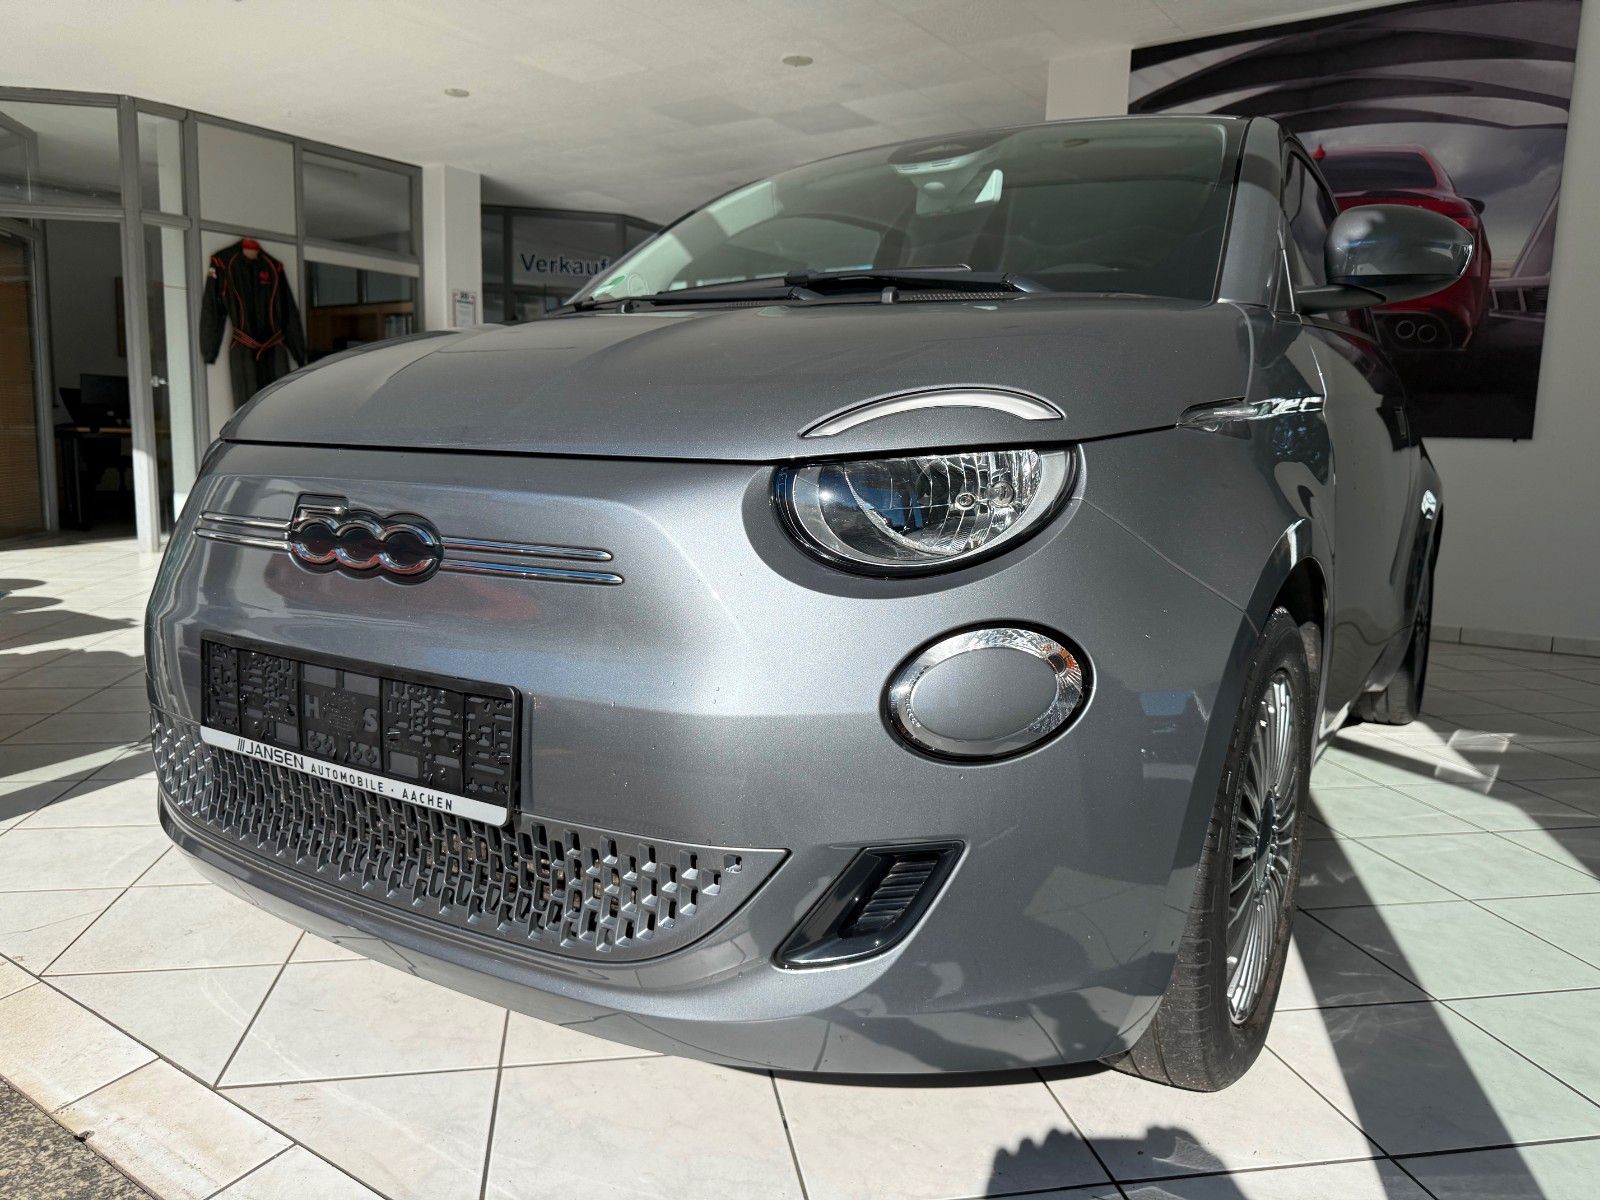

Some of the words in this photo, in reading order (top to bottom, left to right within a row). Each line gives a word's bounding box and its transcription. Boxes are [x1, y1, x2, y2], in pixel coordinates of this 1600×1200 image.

[520, 253, 608, 276] Verkauf
[287, 496, 440, 580] 500
[246, 742, 304, 770] JANSEN
[311, 763, 384, 793] AUTOMOBILE
[402, 788, 453, 812] AACHEN
